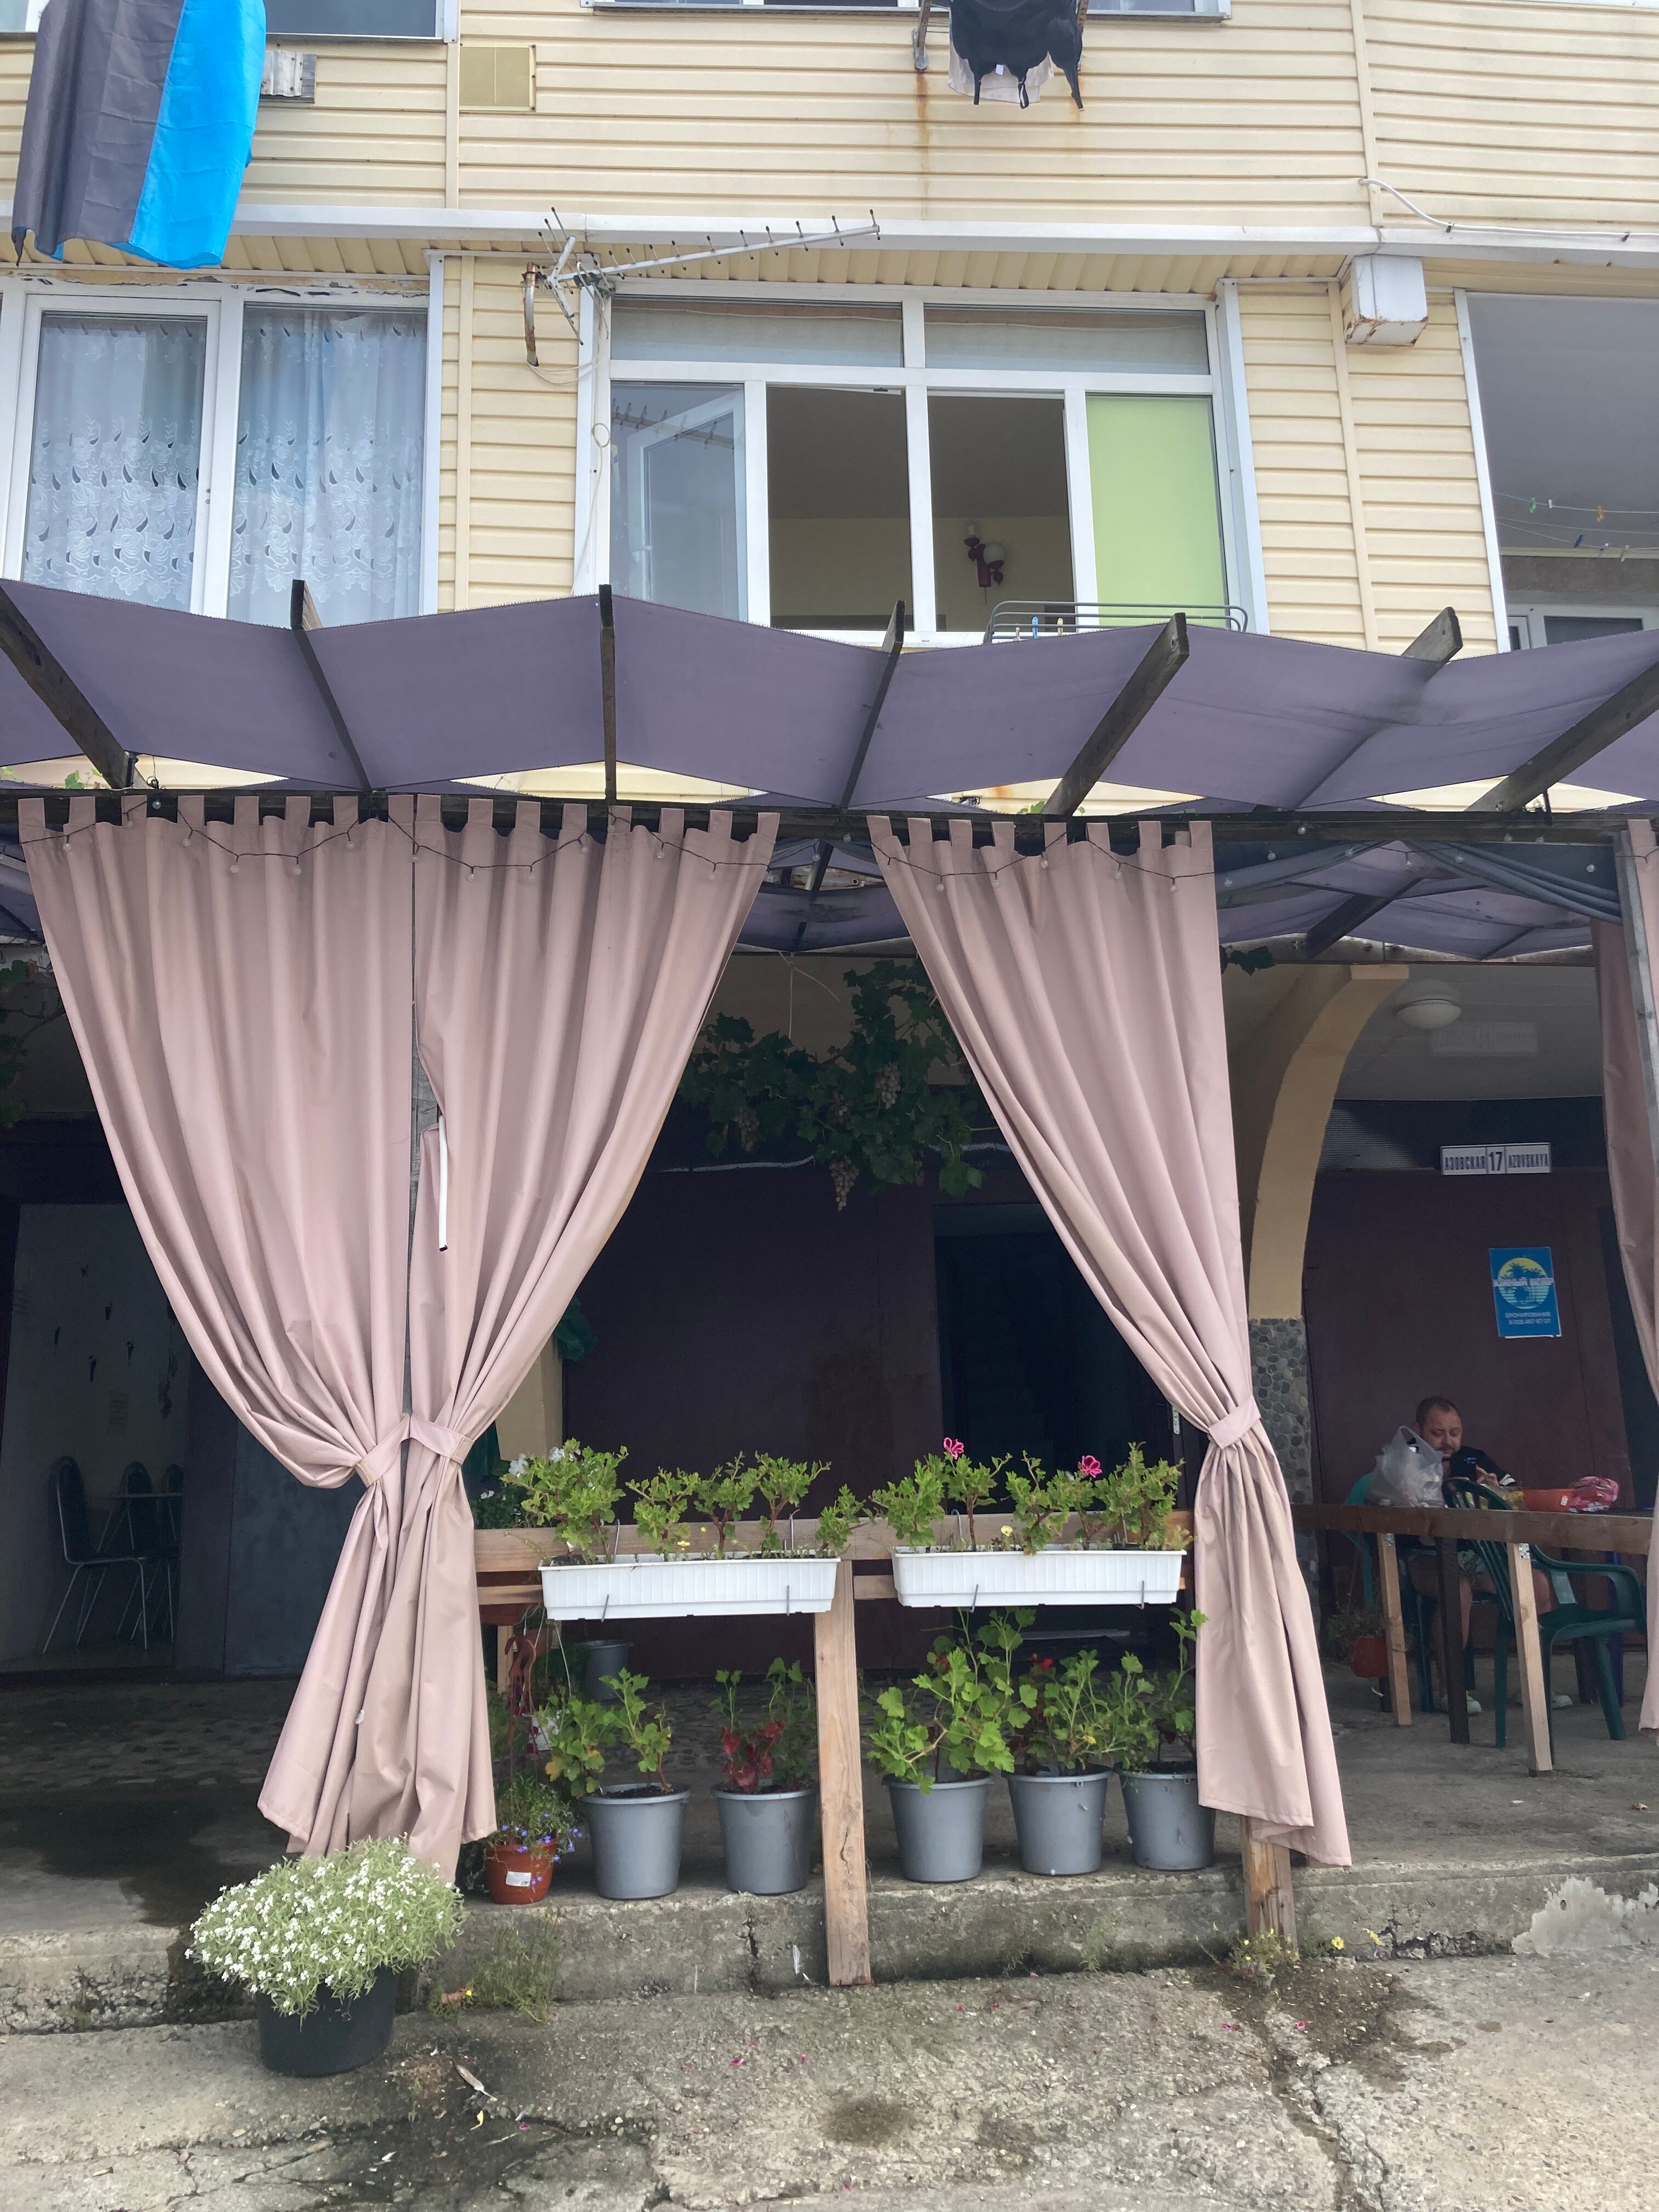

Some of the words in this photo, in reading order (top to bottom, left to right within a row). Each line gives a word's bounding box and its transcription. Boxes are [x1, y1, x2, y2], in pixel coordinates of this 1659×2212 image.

[1444, 1155, 1486, 1170] АЗОВСКАЯ
[1488, 1151, 1503, 1171] 17
[1508, 1153, 1549, 1168] AZOVSKAYA
